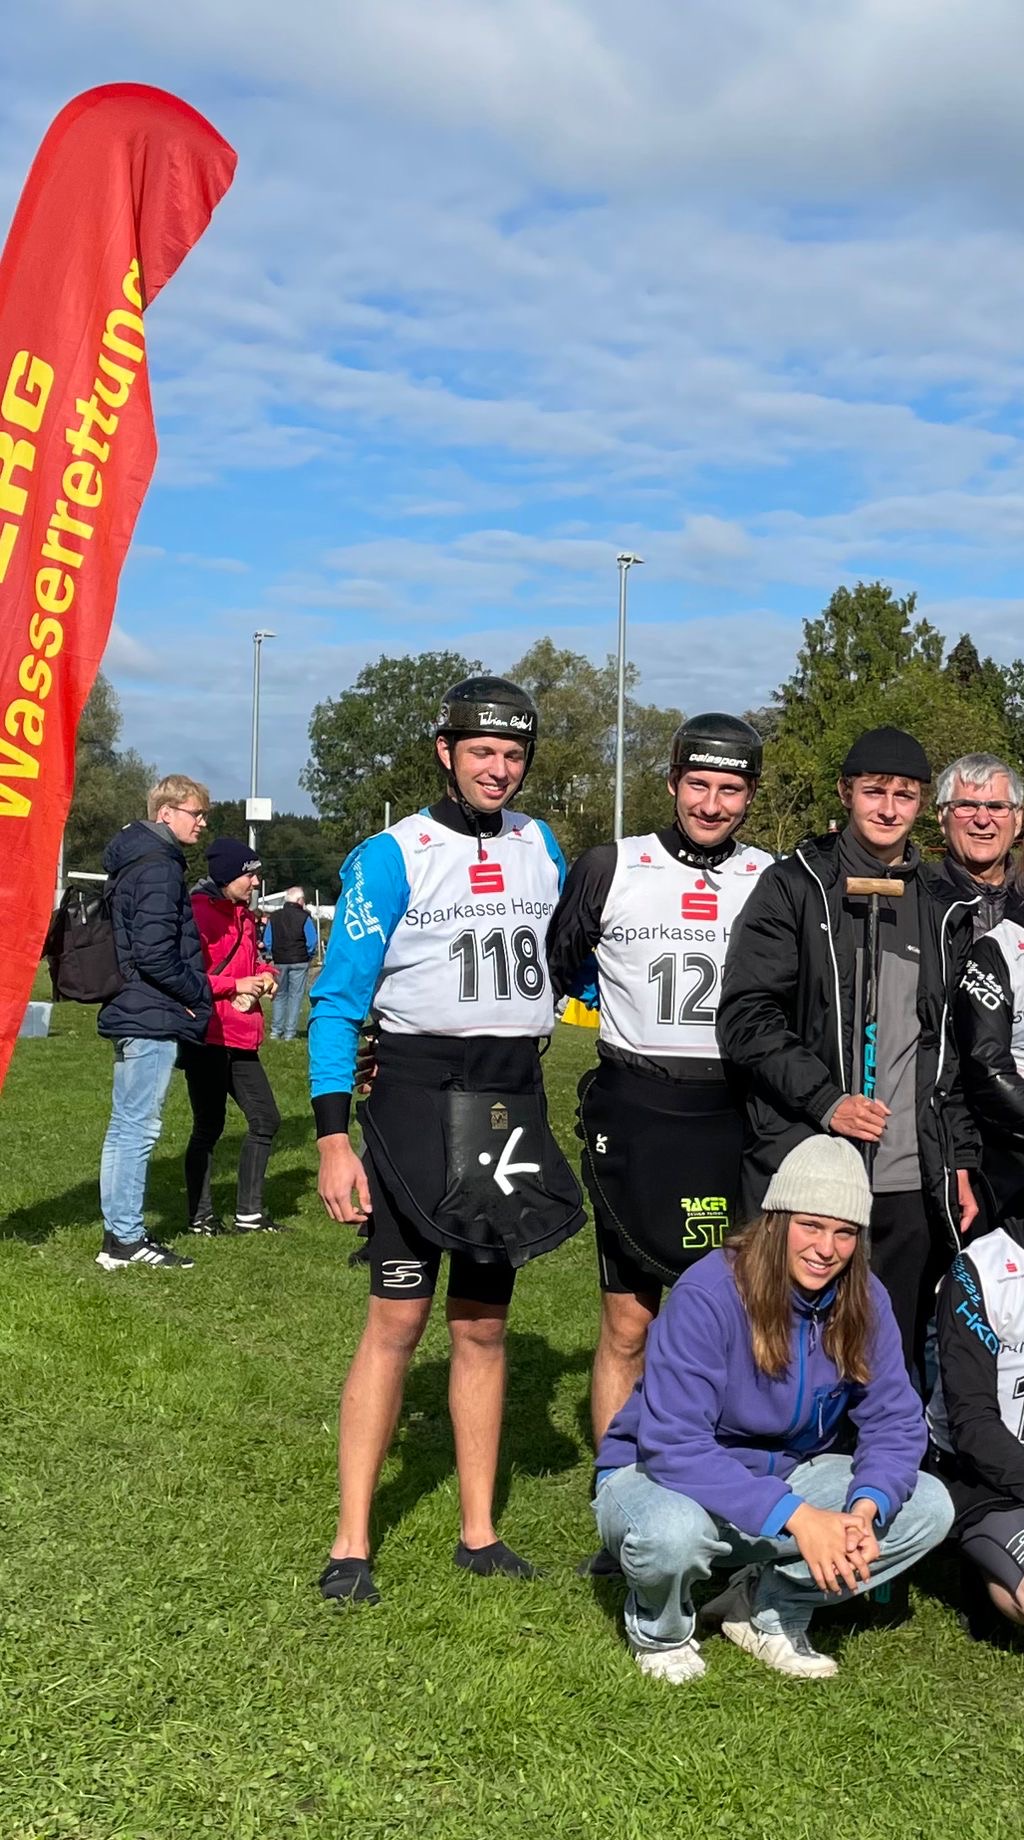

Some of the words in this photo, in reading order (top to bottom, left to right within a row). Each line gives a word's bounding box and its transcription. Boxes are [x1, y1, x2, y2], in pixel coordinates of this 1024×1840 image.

[405, 902, 506, 929] Sparkasse
[612, 923, 716, 945] Sparkasse
[449, 925, 546, 1002] 118
[648, 952, 725, 1026] 12
[681, 1197, 727, 1212] RACER
